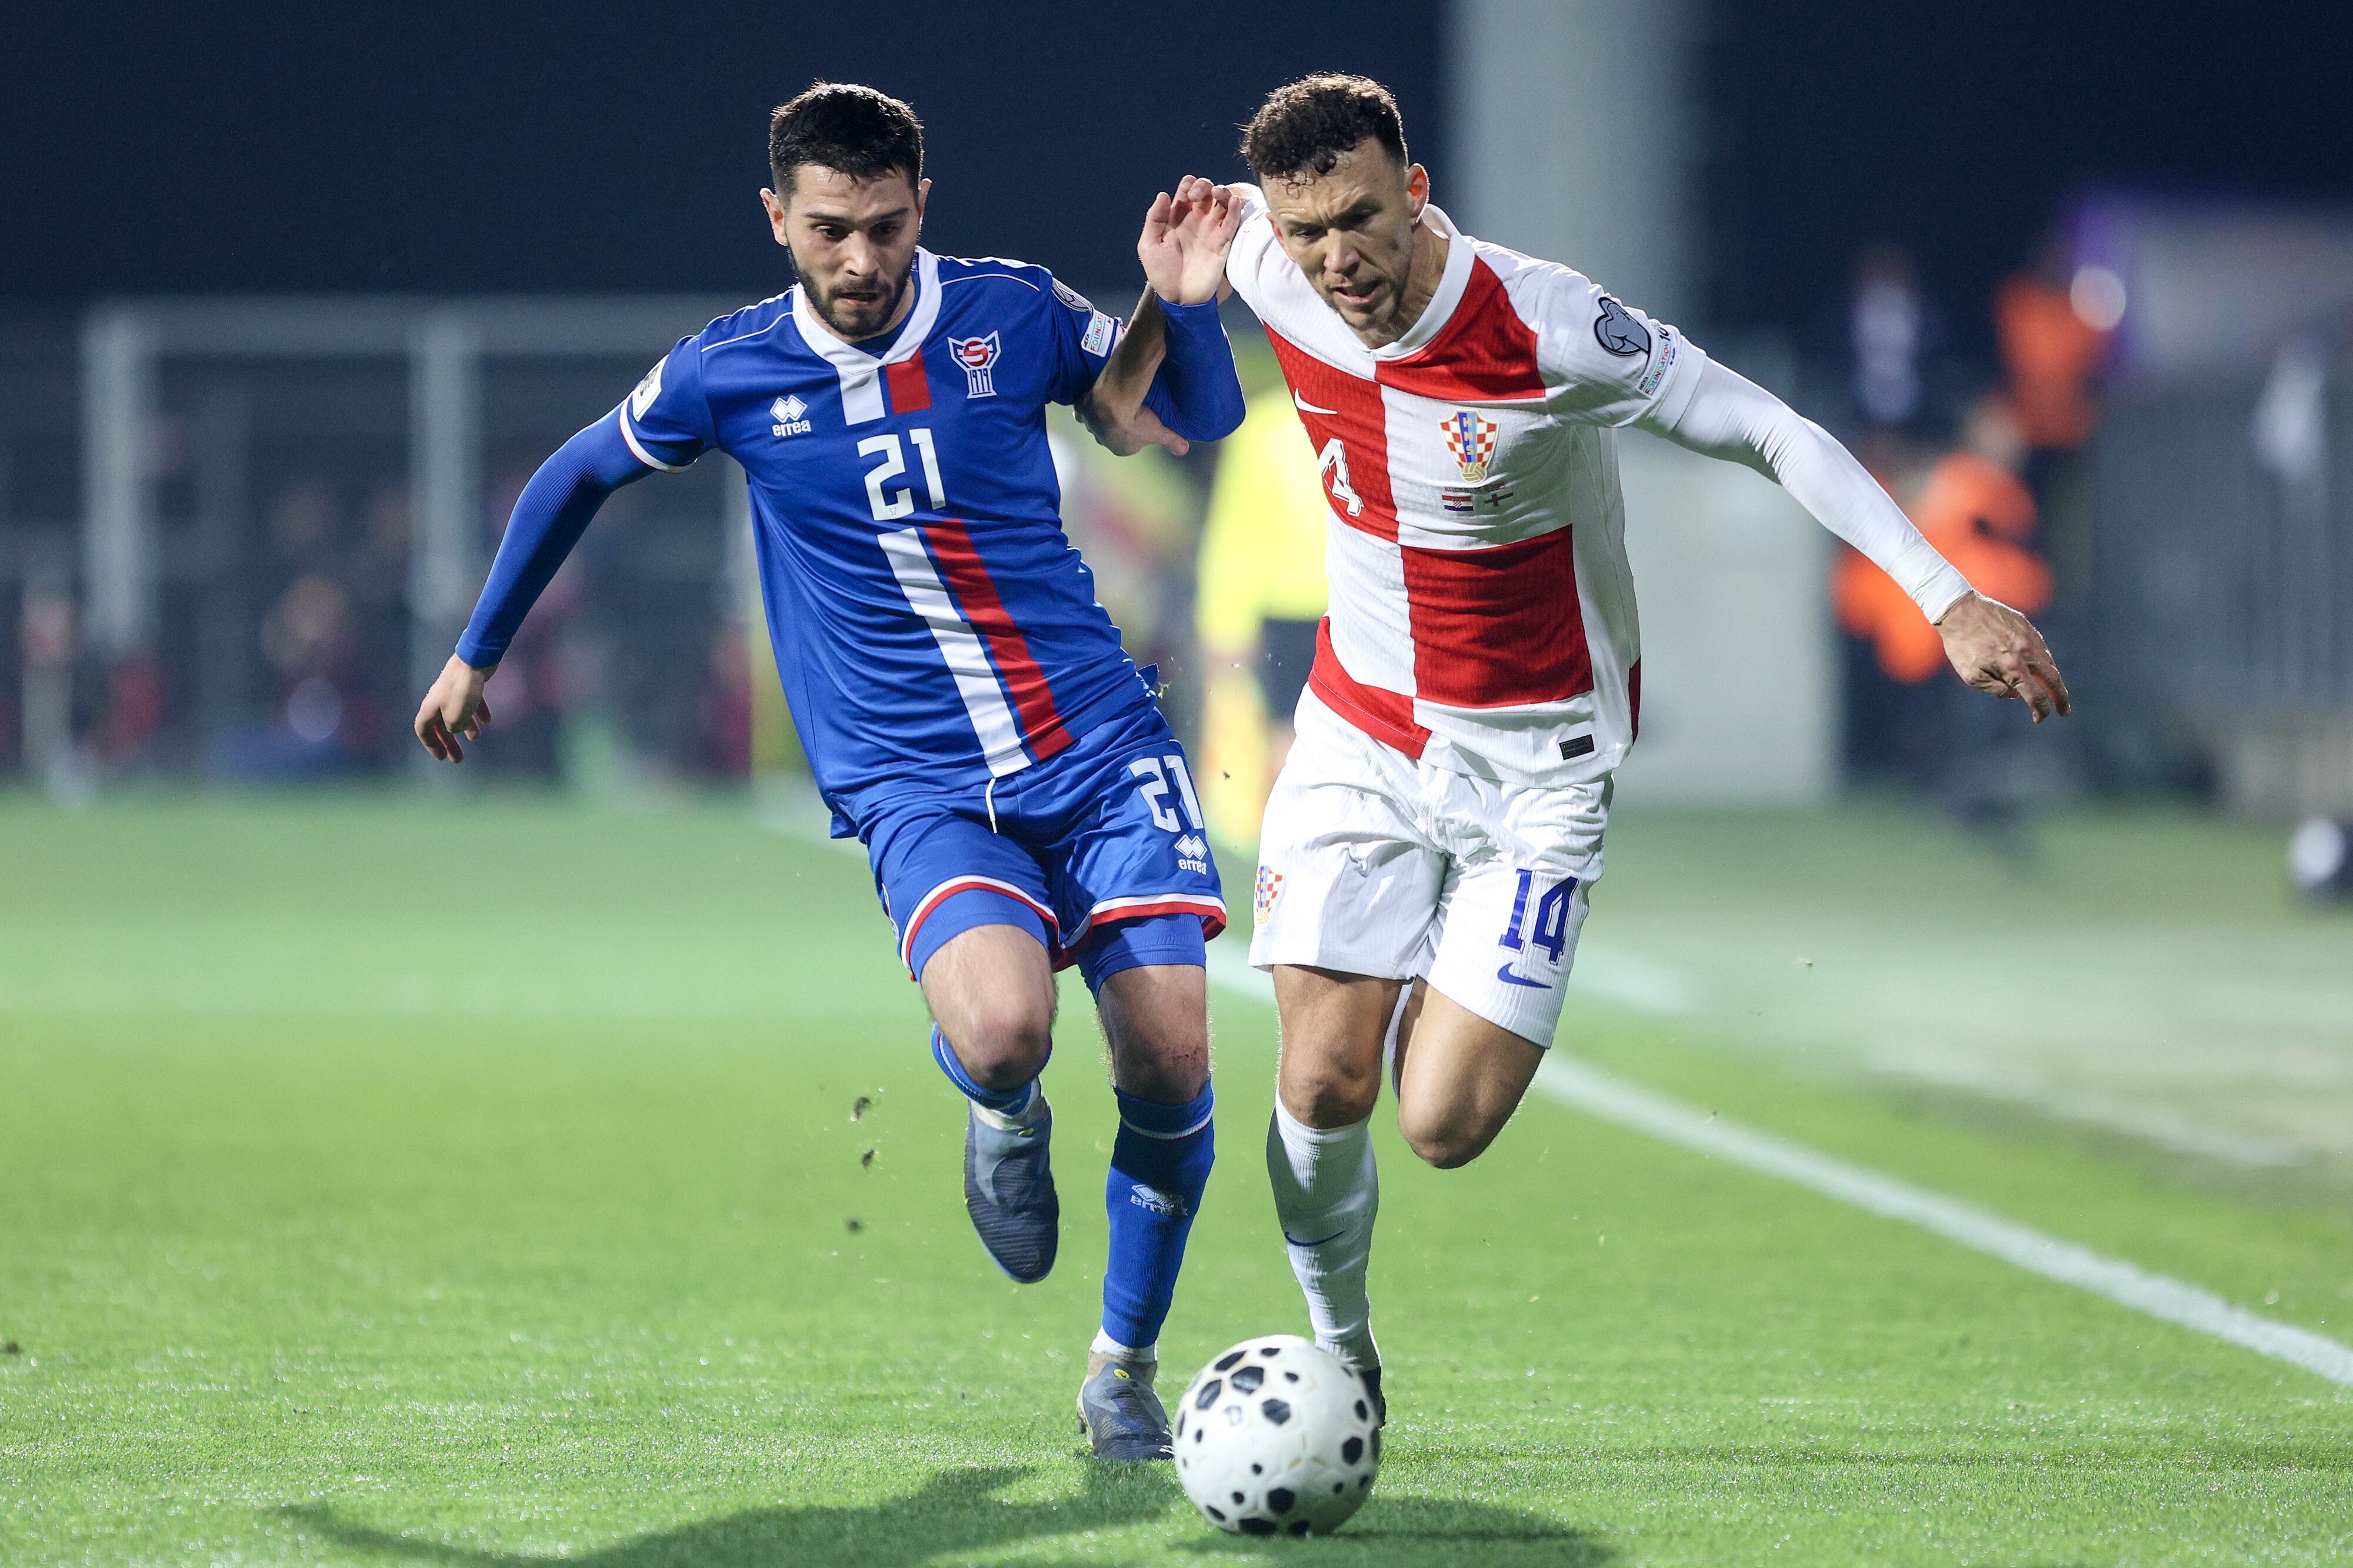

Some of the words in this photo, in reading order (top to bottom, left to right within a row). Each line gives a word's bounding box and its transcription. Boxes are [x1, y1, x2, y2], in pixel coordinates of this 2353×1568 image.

[1090, 313, 1104, 352] FOUNDAT
[969, 368, 991, 393] 1979
[1644, 343, 1670, 395] FOUNDATION
[772, 419, 812, 437] errea
[1462, 416, 1475, 455] HNS
[856, 428, 947, 521] 21
[1314, 434, 1365, 518] 4
[1128, 755, 1204, 833] 21
[1178, 858, 1207, 876] errea
[1498, 868, 1579, 966] 14
